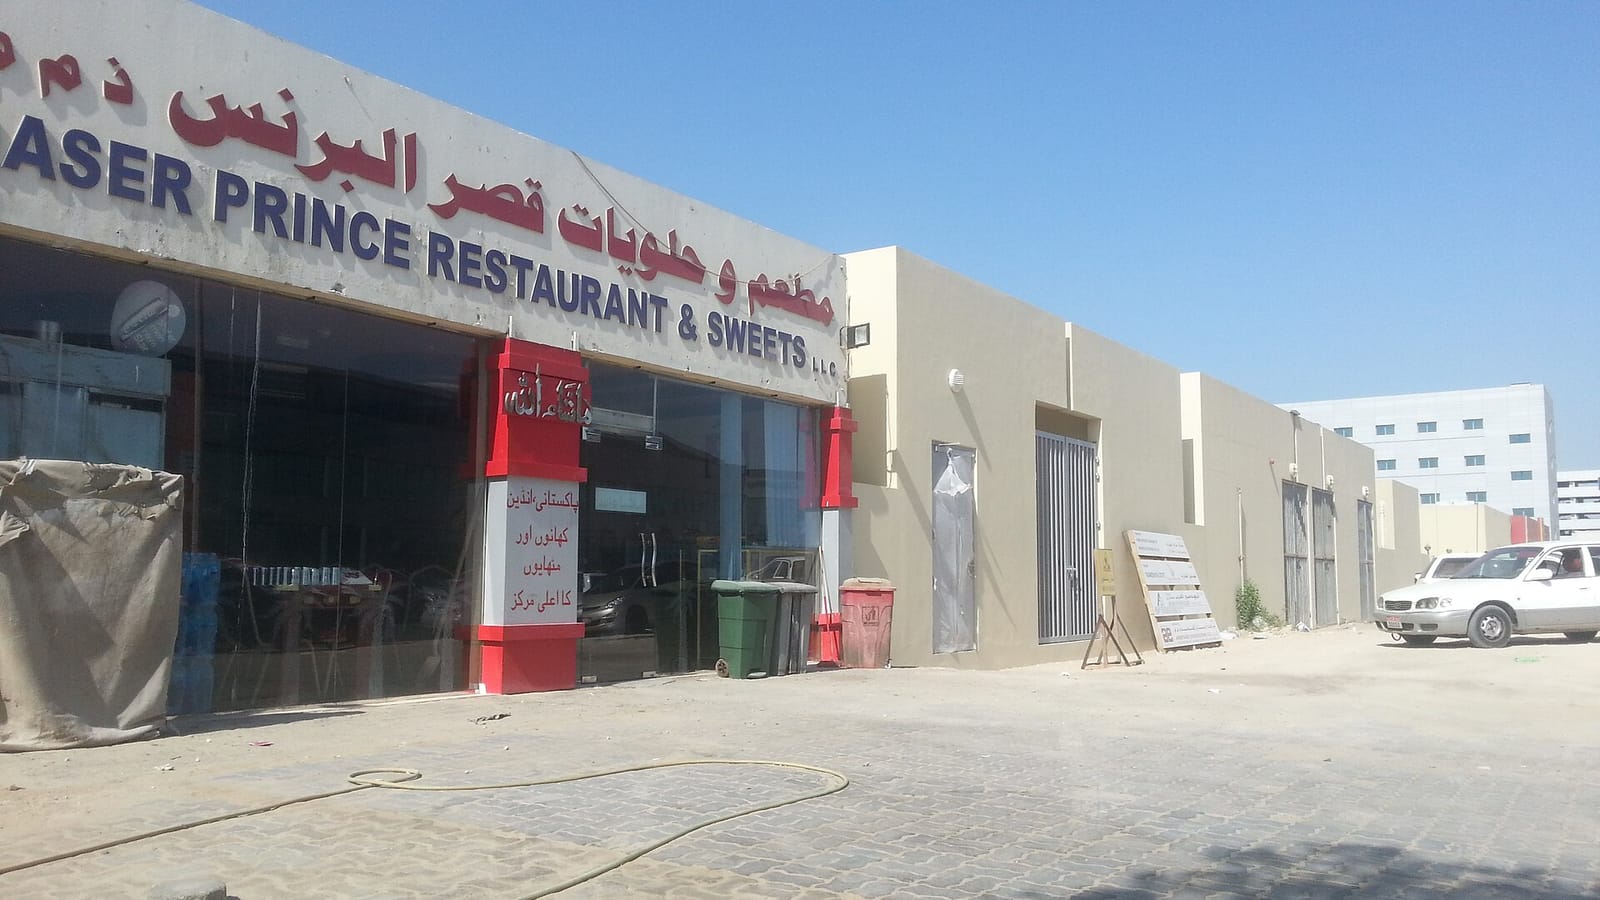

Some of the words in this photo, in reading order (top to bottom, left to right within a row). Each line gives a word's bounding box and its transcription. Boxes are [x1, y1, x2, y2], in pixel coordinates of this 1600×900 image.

[167, 88, 417, 194] البرنس
[427, 173, 544, 234] قصر
[2, 114, 192, 215] ASER
[213, 169, 411, 270] PRINCE
[428, 231, 668, 333] RESTAURANT
[678, 303, 697, 341] &
[708, 311, 805, 369] SWEETS
[557, 203, 706, 285] حلويات
[714, 258, 737, 304] و
[748, 273, 834, 327] مطعم
